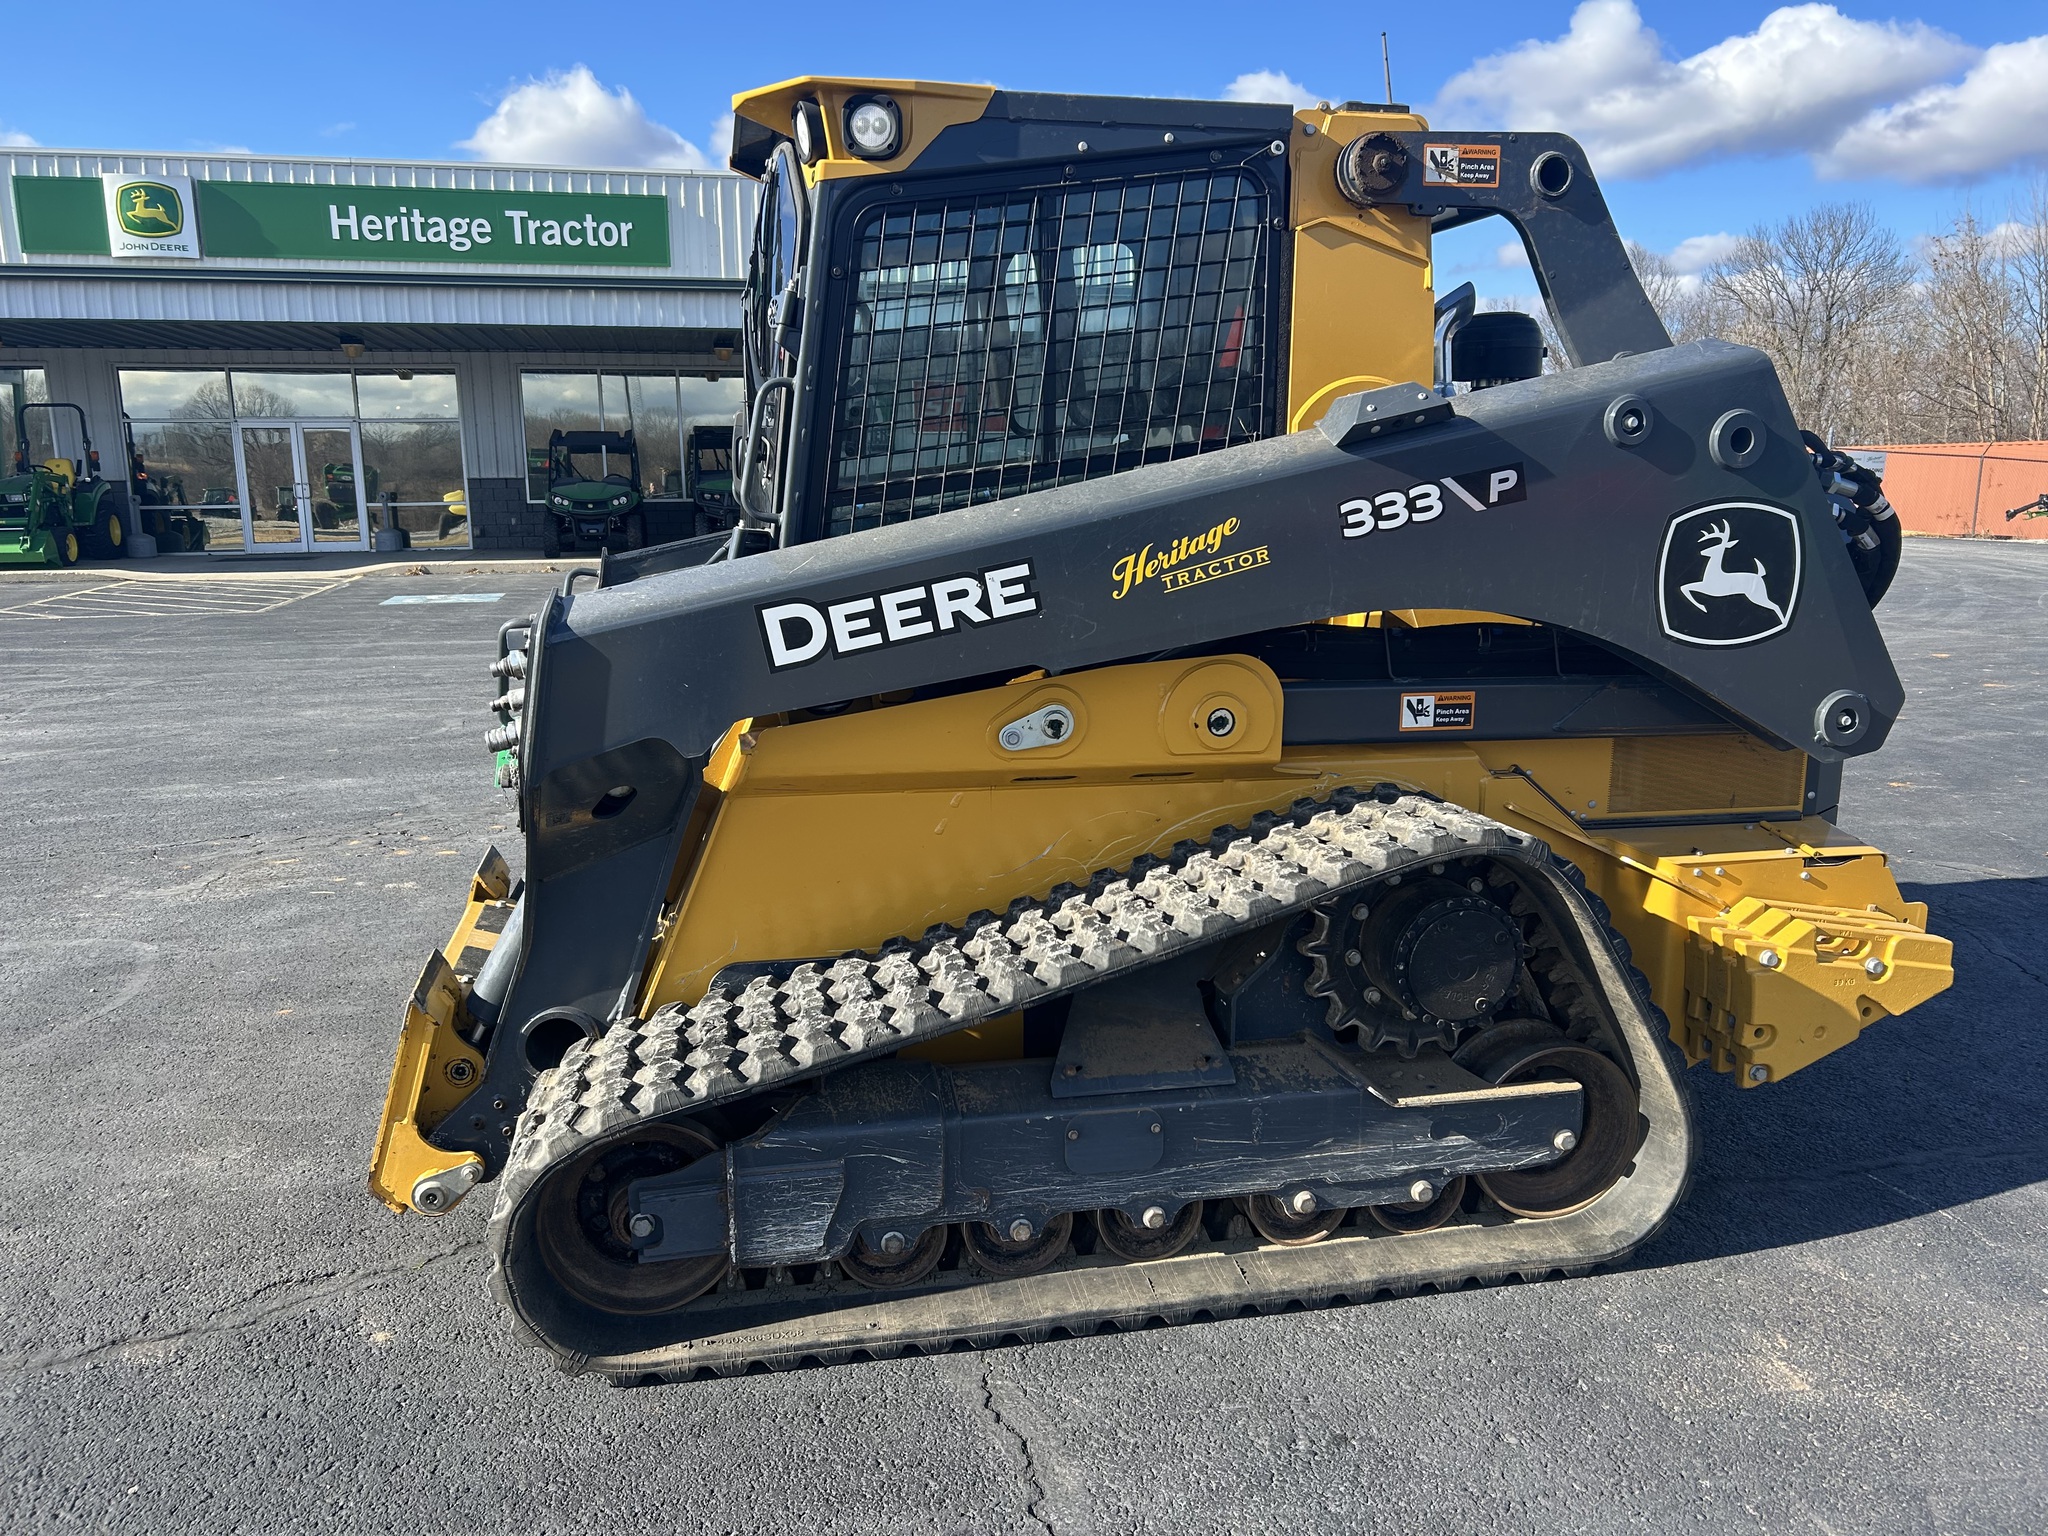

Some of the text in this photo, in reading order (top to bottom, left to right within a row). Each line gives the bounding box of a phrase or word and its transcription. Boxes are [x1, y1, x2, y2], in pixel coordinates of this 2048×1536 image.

[119, 242, 189, 252] JOHN DEERE
[328, 204, 635, 252] Heritage Tractor
[1340, 483, 1444, 538] 333
[1112, 516, 1241, 600] Heritage
[1163, 549, 1270, 589] TRACTOR
[762, 563, 1037, 667] DEERE
